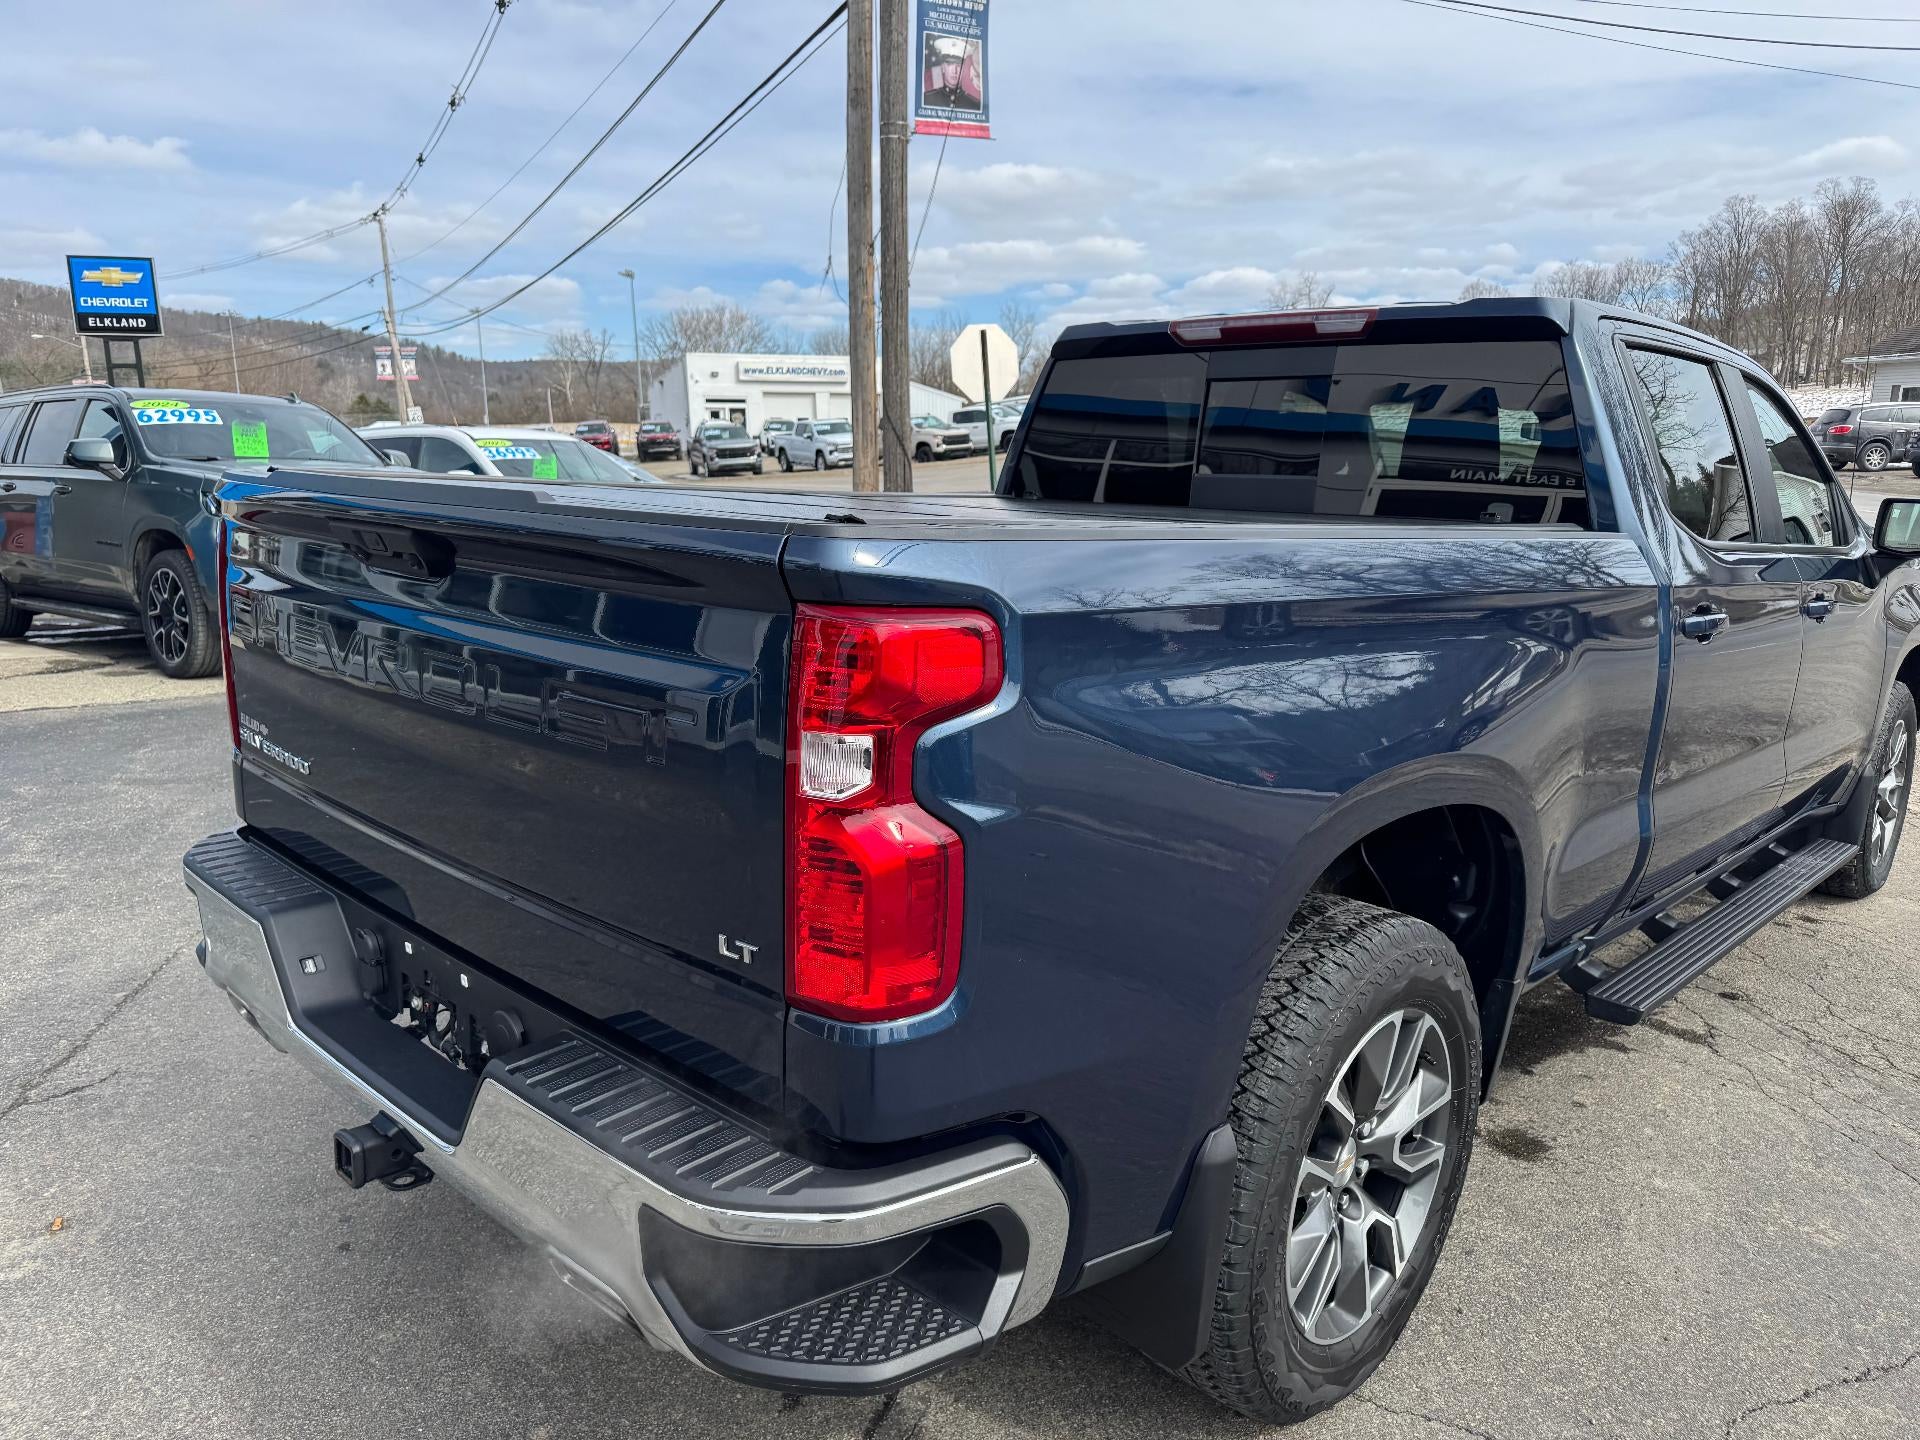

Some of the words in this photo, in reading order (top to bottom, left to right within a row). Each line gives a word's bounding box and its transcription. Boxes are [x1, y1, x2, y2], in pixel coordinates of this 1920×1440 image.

[80, 297, 149, 308] CHEVROLET
[88, 317, 147, 328] ELKLAND
[744, 366, 846, 377] www.ELKLANDCHEVY.com
[137, 409, 217, 423] 62995
[483, 447, 537, 459] 36995
[230, 590, 699, 767] CHEVROLET
[240, 726, 311, 776] SILVERADO
[718, 933, 760, 965] LT
